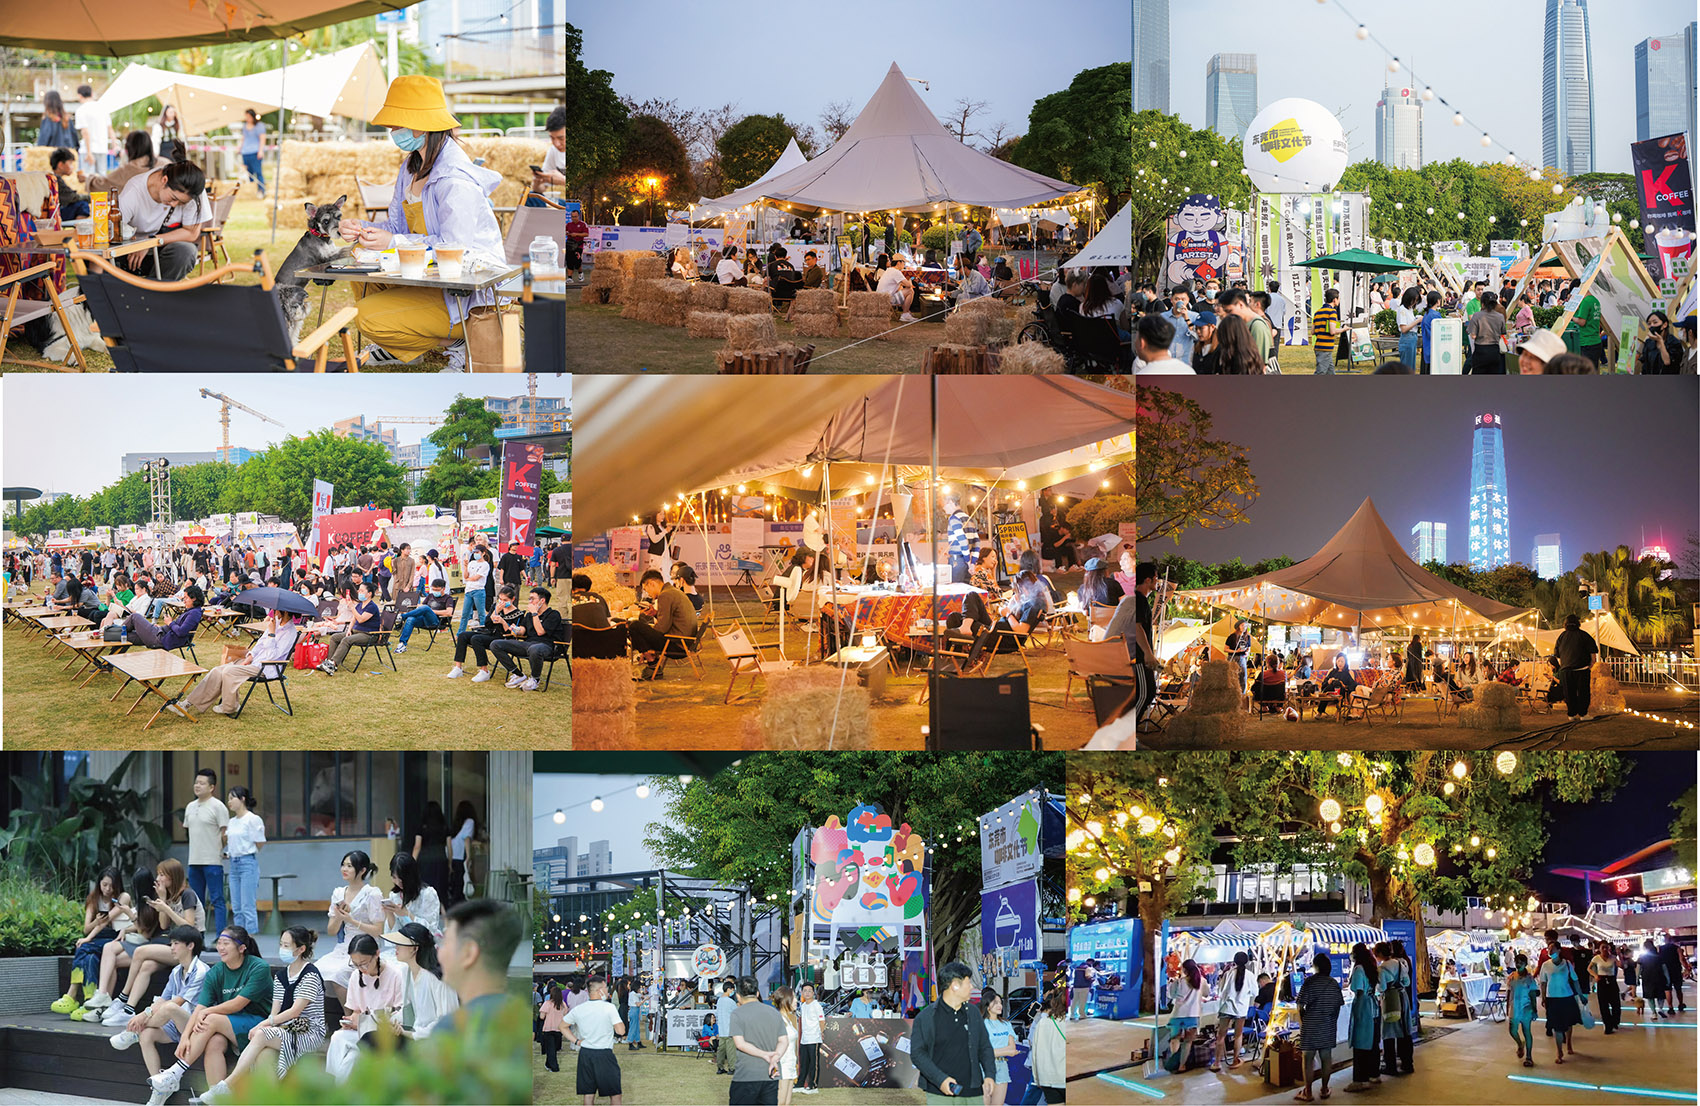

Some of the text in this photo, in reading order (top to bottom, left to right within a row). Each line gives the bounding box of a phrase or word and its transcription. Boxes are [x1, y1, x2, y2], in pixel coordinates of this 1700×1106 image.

[1252, 129, 1279, 146] 东莞市
[1260, 136, 1312, 153] 咖啡文化节
[1641, 163, 1685, 208] K
[1656, 190, 1689, 201] COFFEE
[1176, 251, 1219, 260] BARISTA
[508, 461, 535, 493] K
[515, 480, 538, 489] COFFEE
[511, 521, 528, 543] K
[999, 525, 1025, 534] SPRING
[989, 826, 1006, 850] 东莞市
[994, 836, 1028, 865] 咖啡文化节
